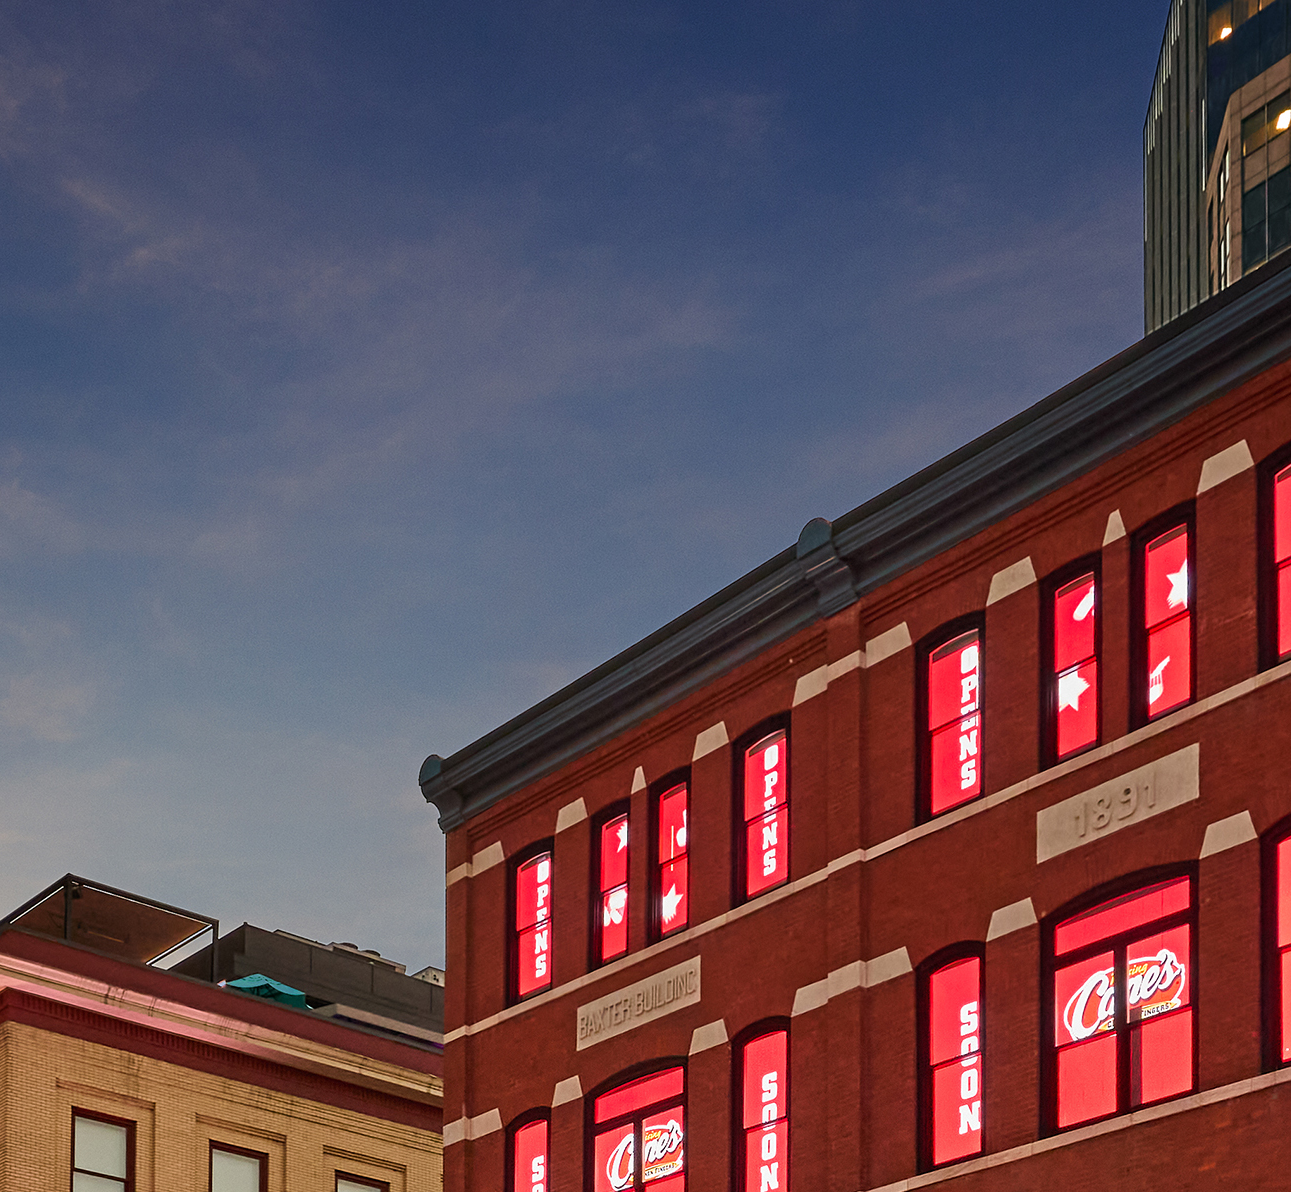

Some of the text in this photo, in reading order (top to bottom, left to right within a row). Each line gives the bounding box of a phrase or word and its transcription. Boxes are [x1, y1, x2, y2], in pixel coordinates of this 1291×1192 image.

[960, 645, 979, 789] OPENS
[763, 745, 779, 877] OPENS
[1074, 784, 1158, 838] 1891
[535, 861, 549, 978] OPENS
[579, 967, 698, 1041] BAXTER BUILDING
[959, 1001, 980, 1134] SOON
[760, 1071, 778, 1192] SOON
